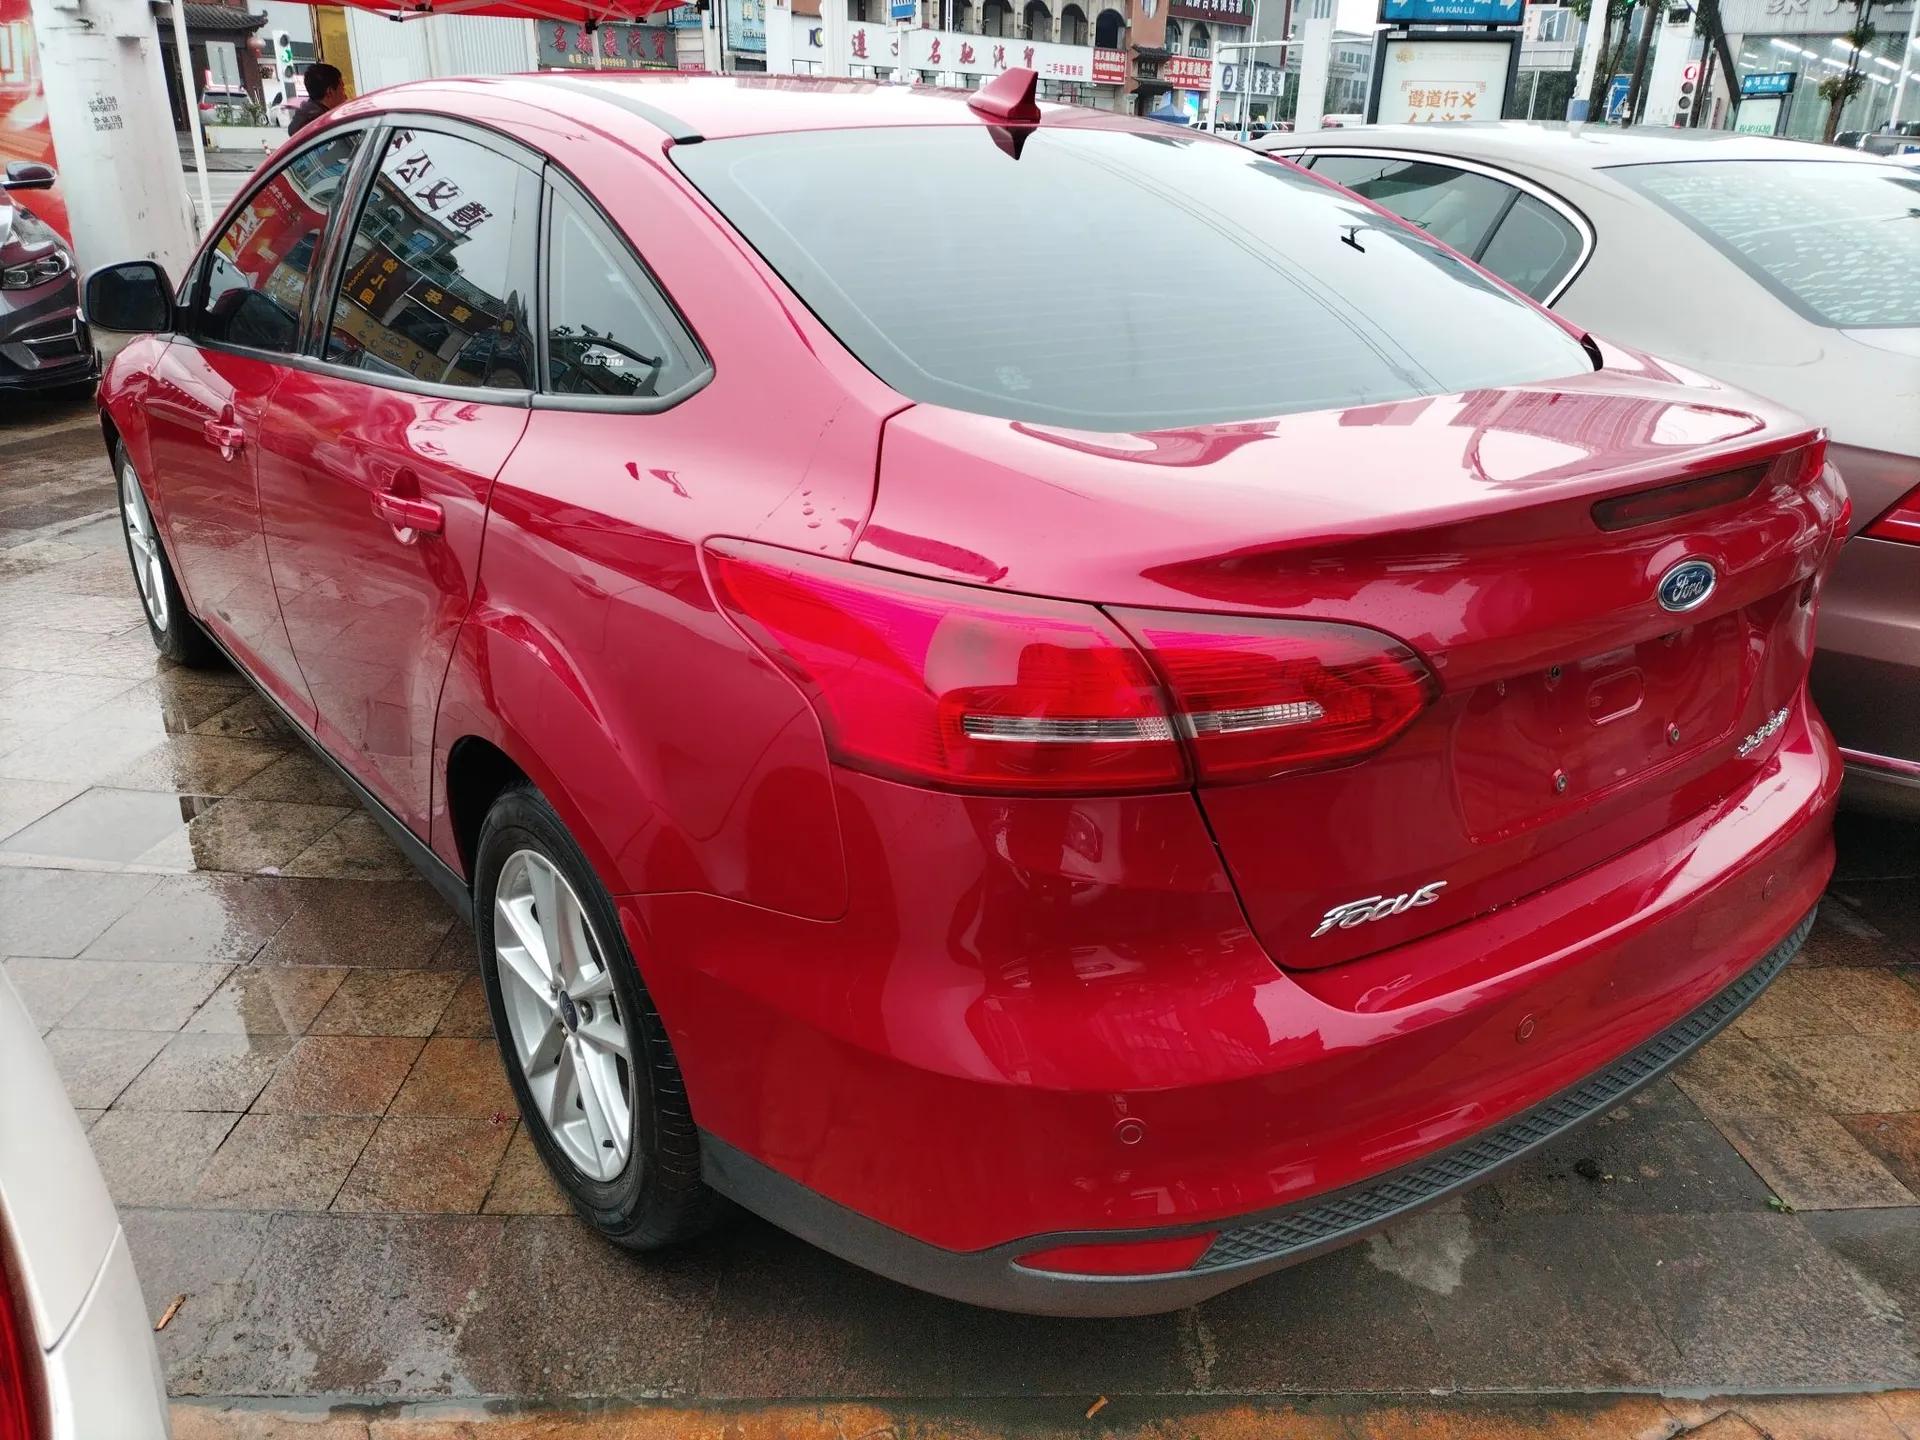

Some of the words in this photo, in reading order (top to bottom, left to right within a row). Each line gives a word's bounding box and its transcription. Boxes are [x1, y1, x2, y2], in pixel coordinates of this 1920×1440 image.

[1431, 5, 1442, 14] MA
[1445, 6, 1461, 14] KAN
[1463, 6, 1475, 14] LU
[1672, 571, 1706, 602] Ford
